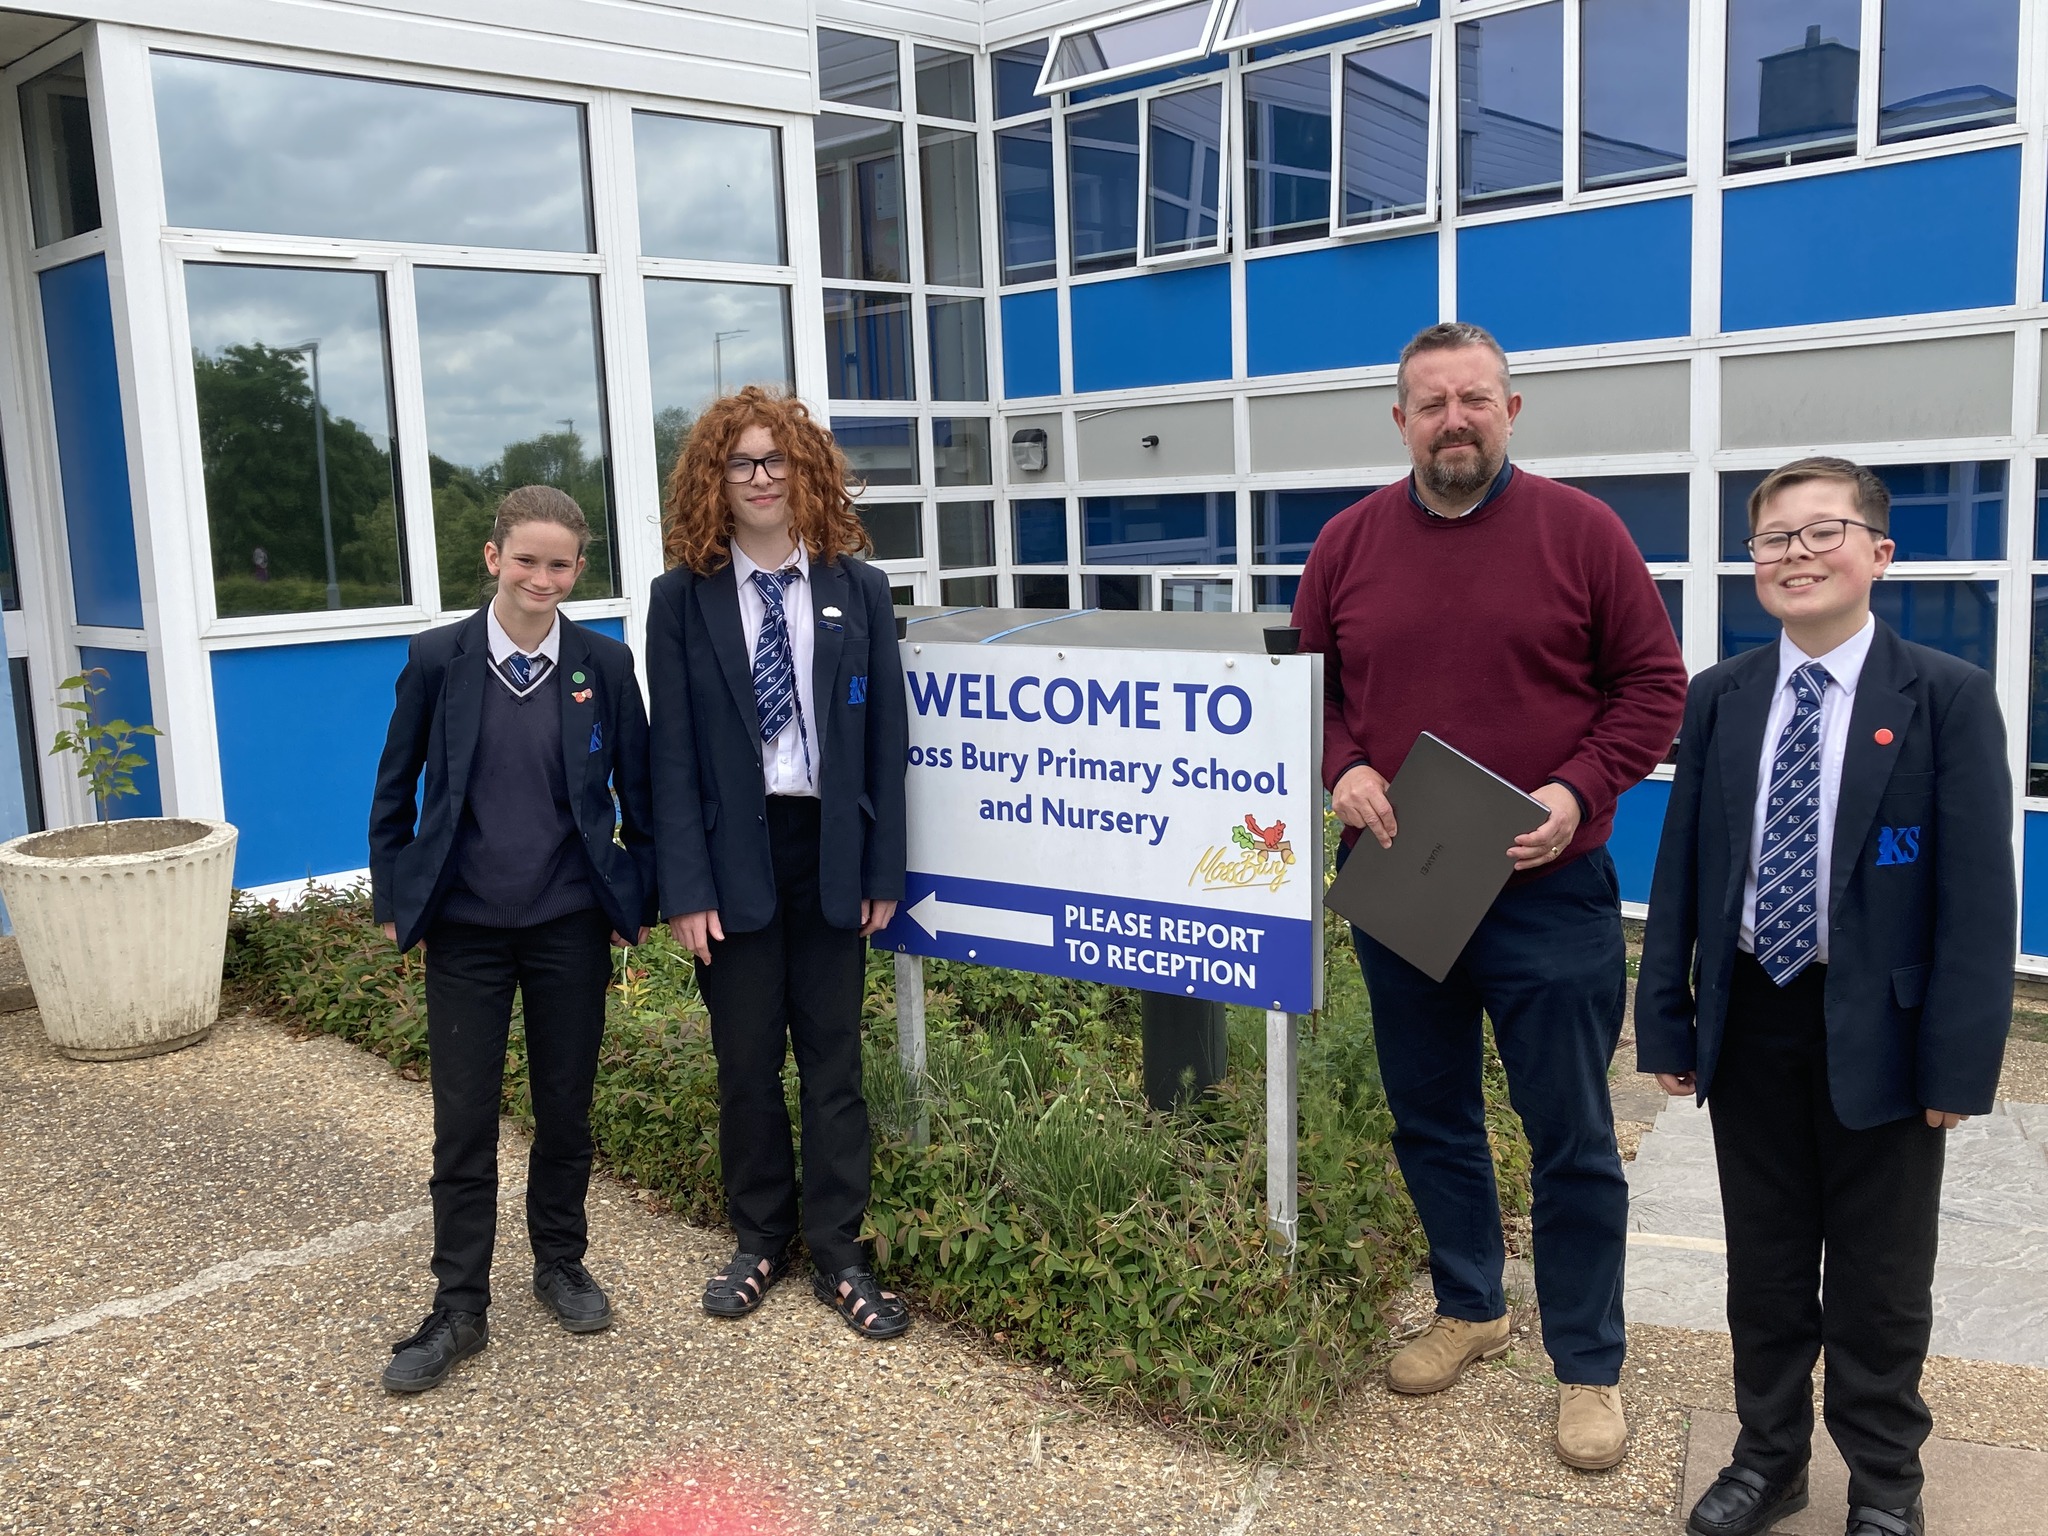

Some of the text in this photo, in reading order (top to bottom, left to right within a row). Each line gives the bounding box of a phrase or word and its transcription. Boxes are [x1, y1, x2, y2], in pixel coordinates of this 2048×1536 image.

[906, 671, 1252, 735] WELCOME TO
[908, 742, 1288, 796] oss Bury Primary School
[979, 794, 1169, 846] and Nursery
[1876, 825, 1920, 866] KS
[1420, 842, 1444, 876] HUAWEI
[1065, 904, 1265, 953] PLEASE REPORT
[1064, 938, 1256, 989] TO RECEPTION
